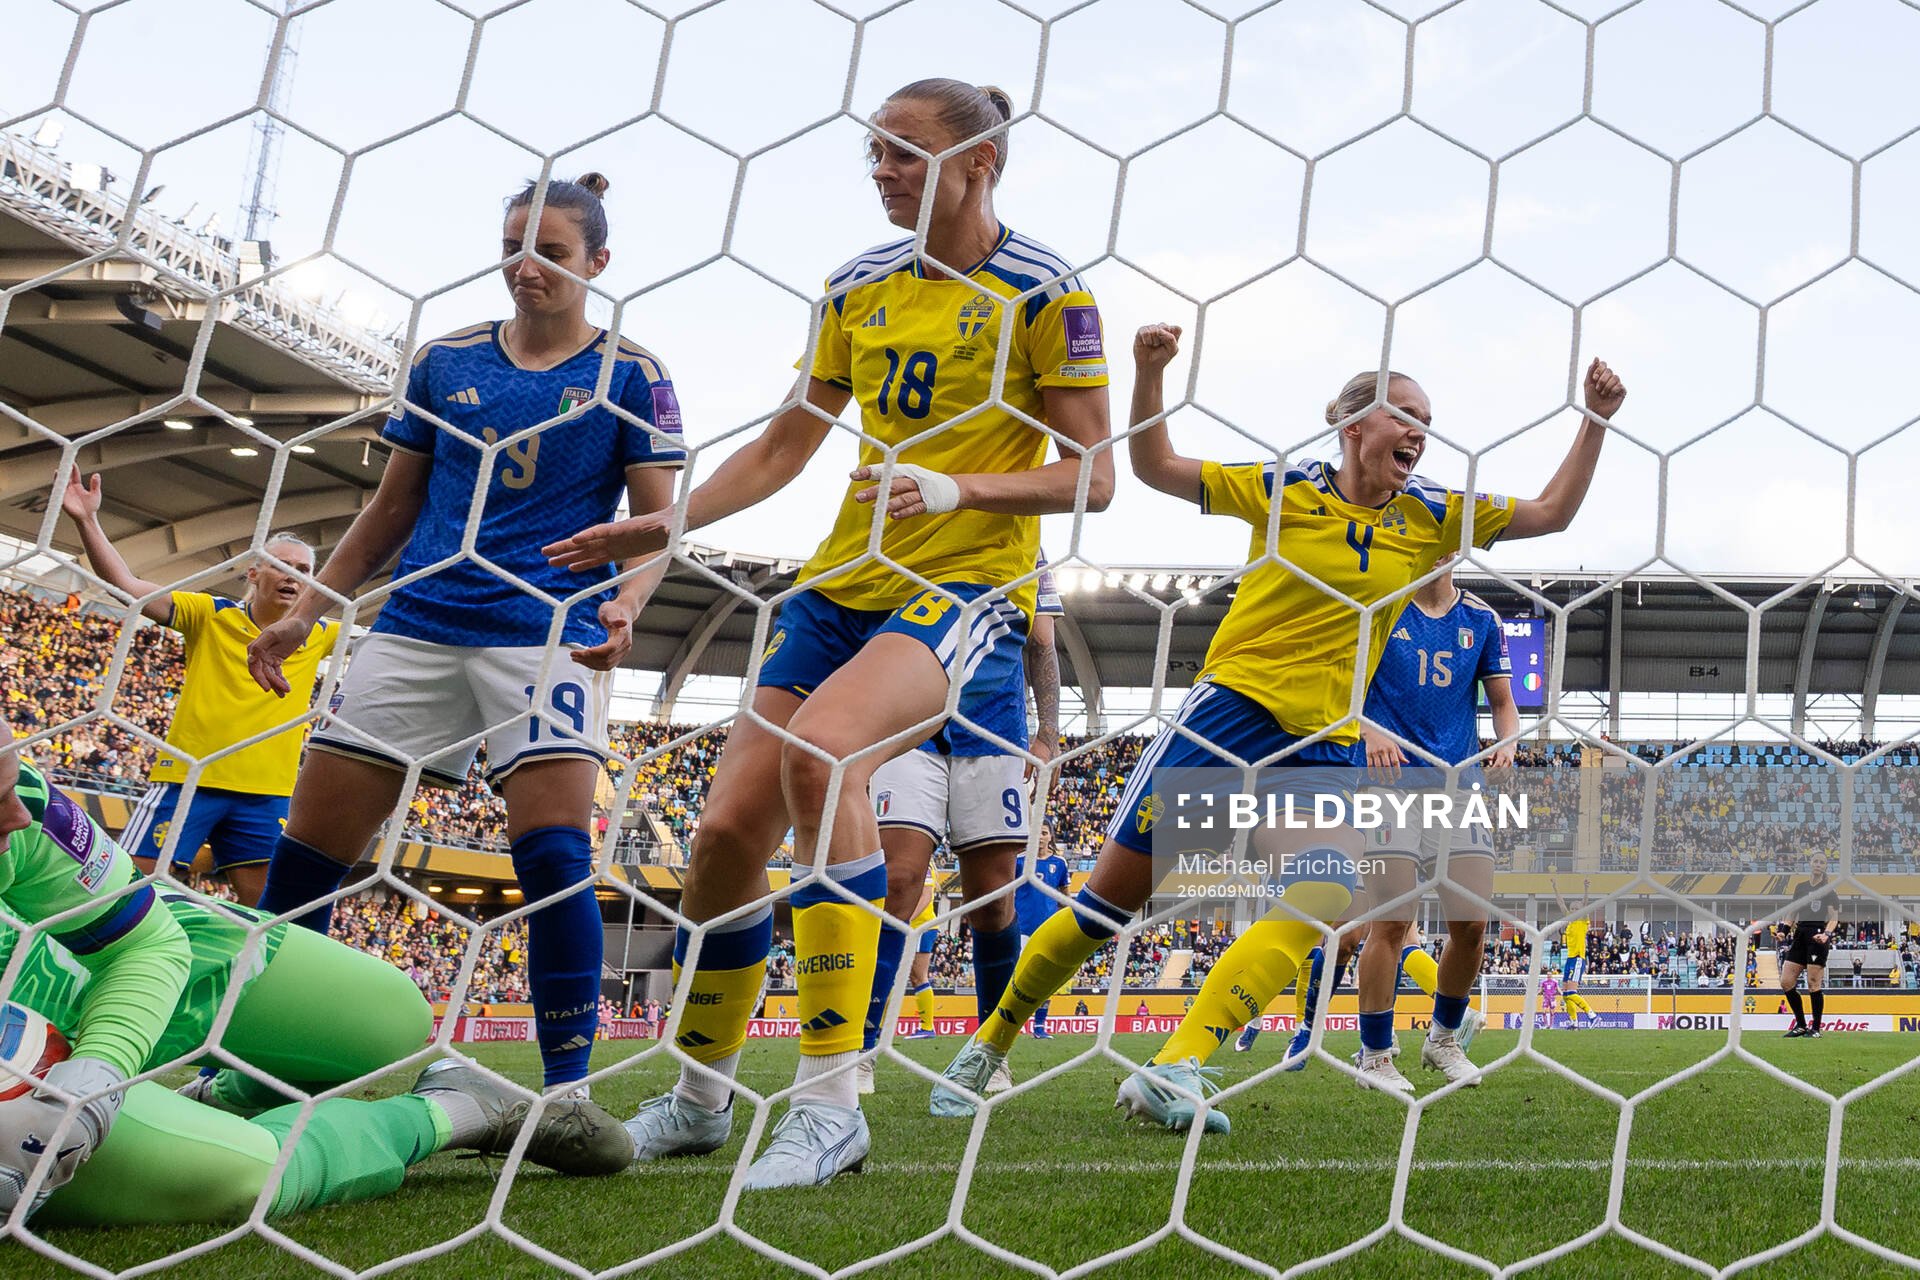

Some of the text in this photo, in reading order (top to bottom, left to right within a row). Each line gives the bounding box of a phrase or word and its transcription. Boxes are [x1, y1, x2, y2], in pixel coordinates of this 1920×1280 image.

[878, 347, 938, 419] 18
[565, 390, 589, 399] ITALIA
[1346, 521, 1373, 572] 4
[1417, 649, 1453, 687] 15
[1530, 653, 1538, 665] 2
[1002, 788, 1022, 828] 9
[797, 953, 855, 975] SVERIGE
[687, 992, 724, 1005] RIGE
[1231, 984, 1259, 1016] SVER
[545, 1001, 595, 1020] ITALIA
[474, 1022, 528, 1040] BAUHAUS
[748, 1022, 801, 1037] AUHA
[1132, 1020, 1181, 1033] BAUH
[1657, 1015, 1731, 1030] MOBIL
[1788, 1017, 1869, 1032] Ierbus
